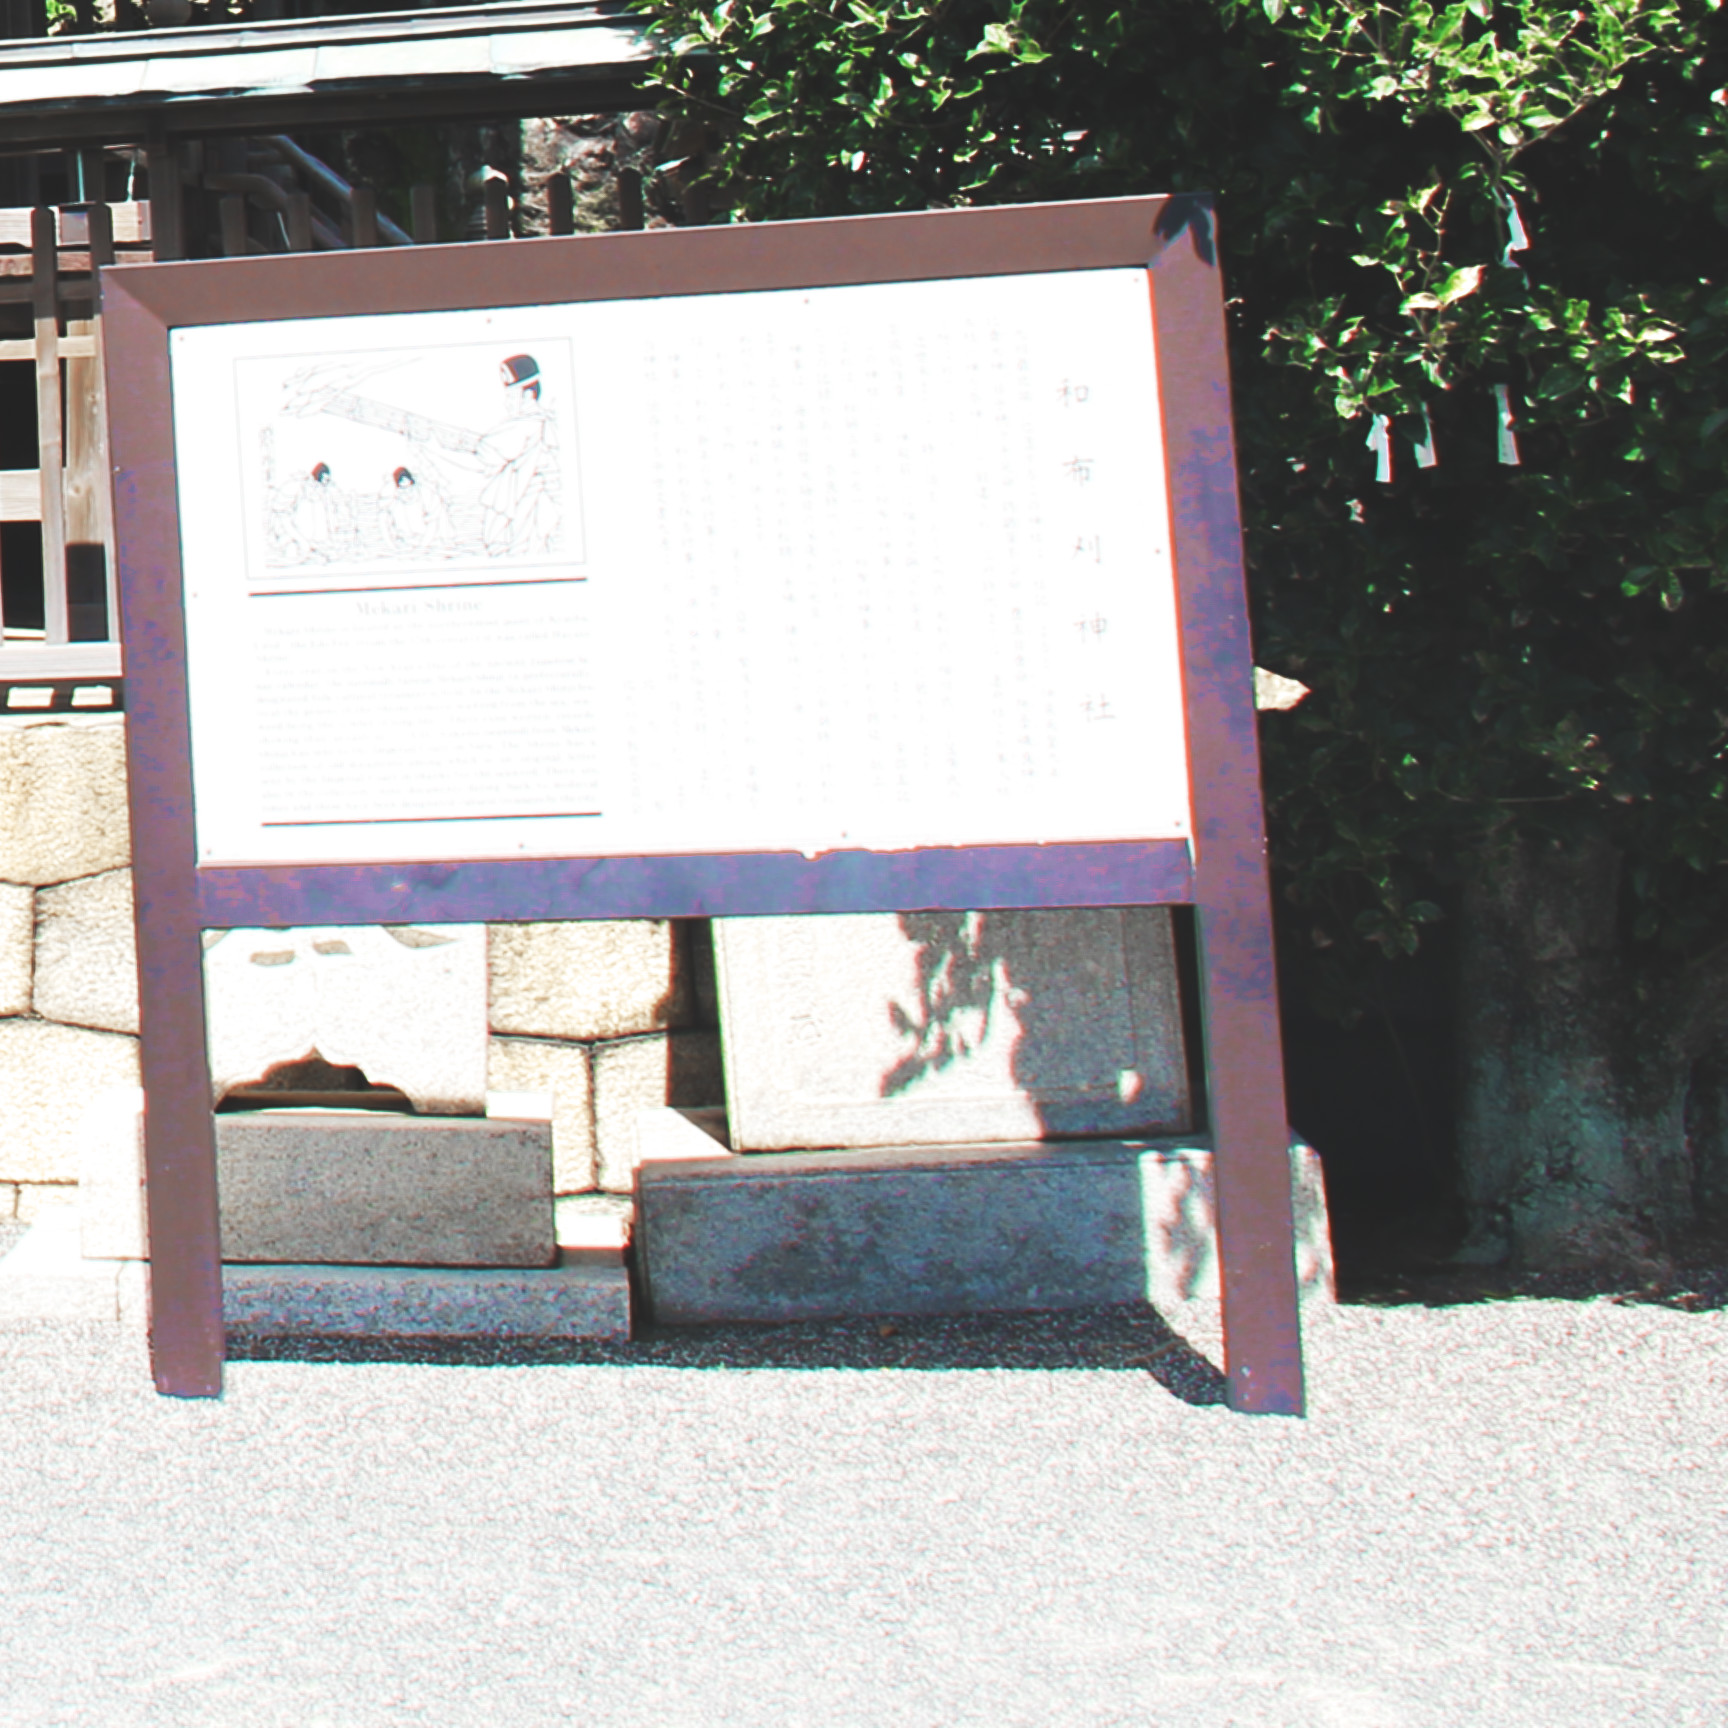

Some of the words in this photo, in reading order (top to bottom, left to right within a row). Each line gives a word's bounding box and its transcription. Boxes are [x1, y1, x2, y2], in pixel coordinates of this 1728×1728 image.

[424, 598, 485, 614] Shrine
[1060, 380, 1117, 724] 和布刈神社
